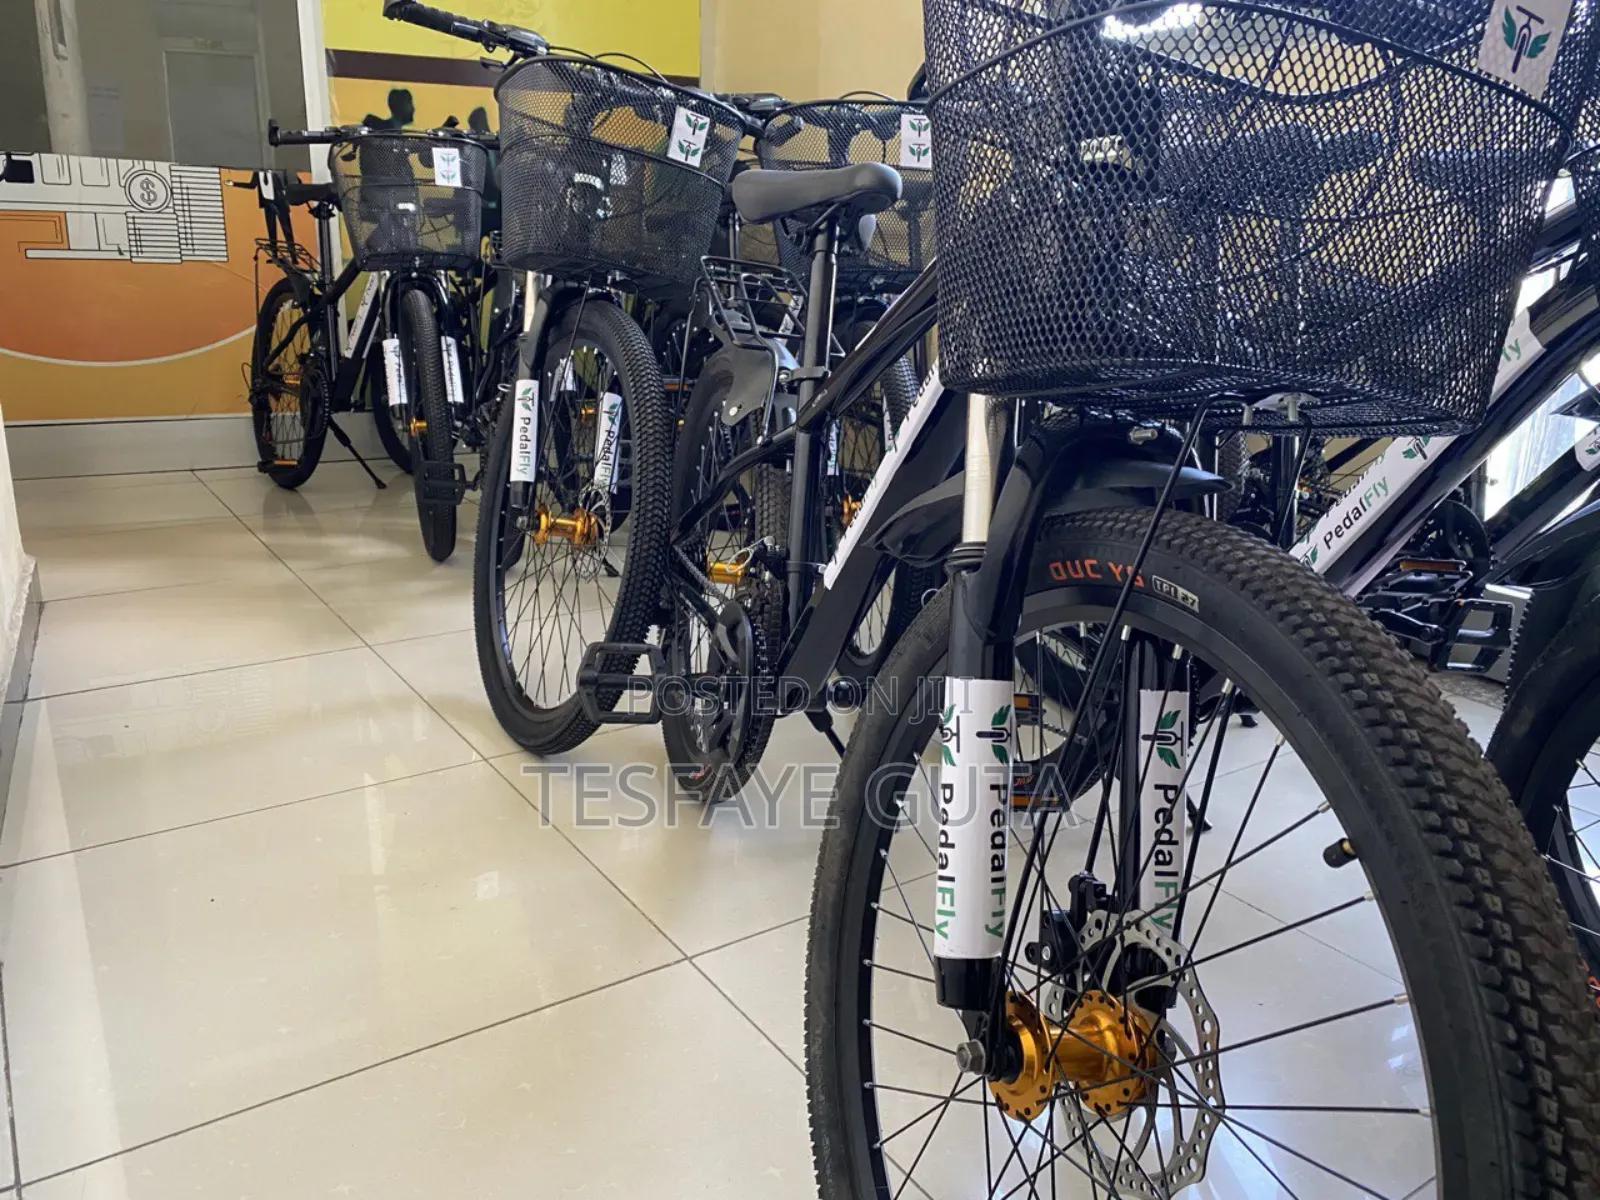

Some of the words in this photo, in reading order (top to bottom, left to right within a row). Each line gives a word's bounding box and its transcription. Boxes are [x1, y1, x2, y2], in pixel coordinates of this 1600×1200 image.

[516, 417, 531, 475] PedalFly
[1323, 476, 1390, 550] PedalFly
[934, 783, 956, 940] PedalFly
[985, 783, 1009, 939] PedalFly
[1151, 783, 1180, 930] PedalFly
